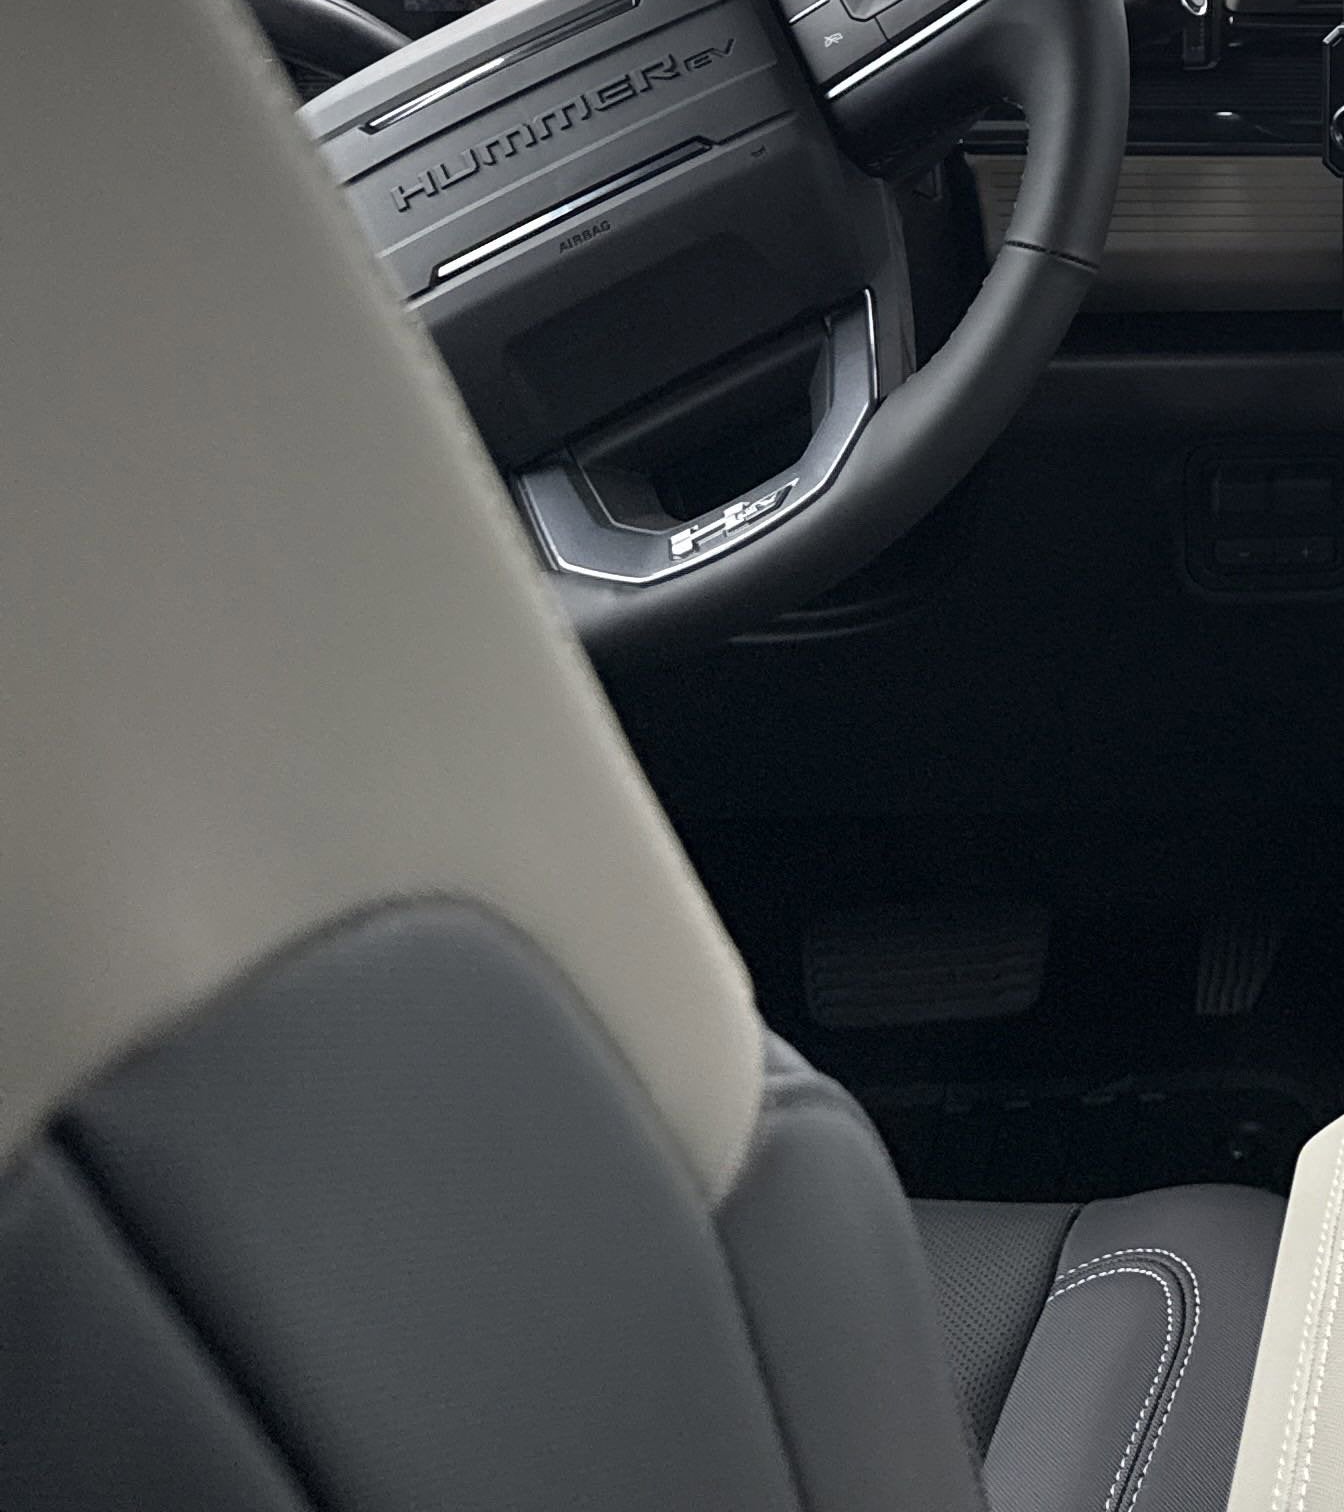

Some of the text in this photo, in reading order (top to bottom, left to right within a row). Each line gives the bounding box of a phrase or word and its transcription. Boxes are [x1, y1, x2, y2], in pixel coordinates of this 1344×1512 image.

[389, 38, 736, 213] HUMMER EV
[559, 220, 612, 254] AIRBAG
